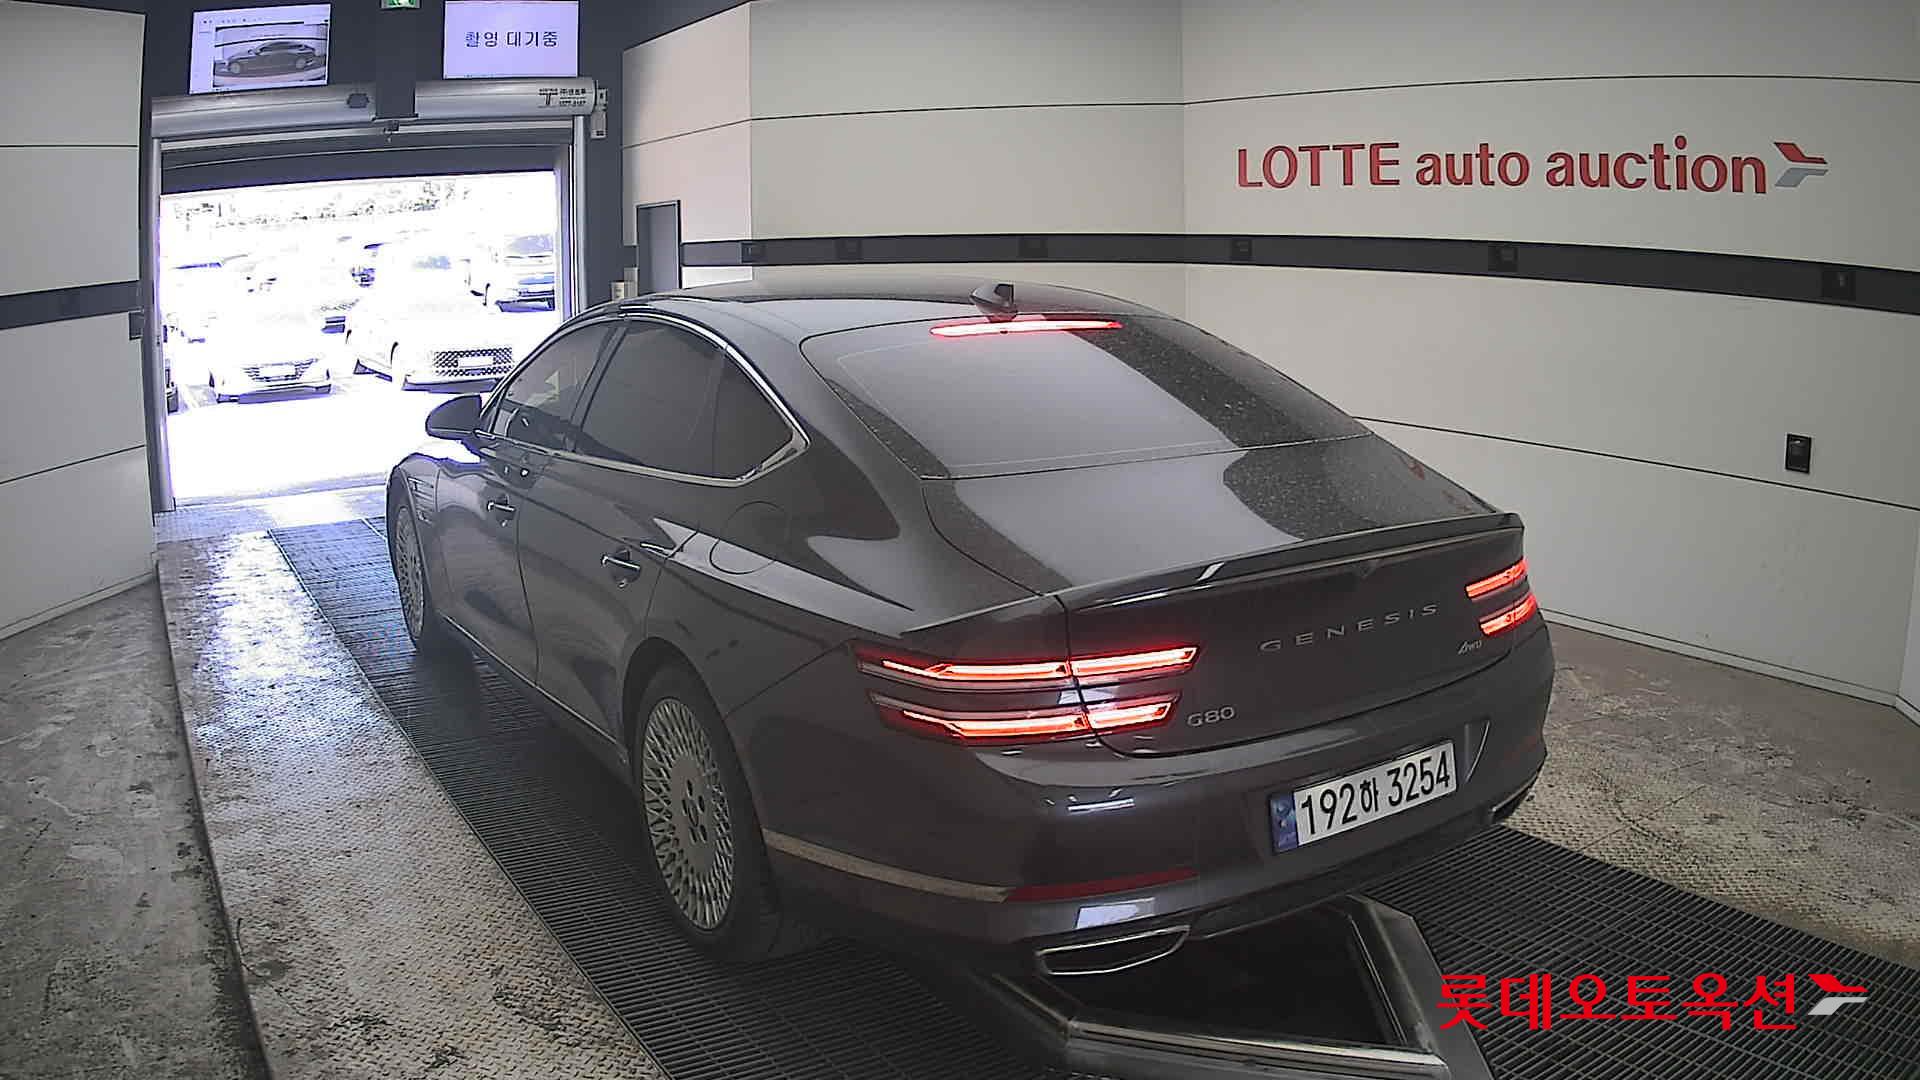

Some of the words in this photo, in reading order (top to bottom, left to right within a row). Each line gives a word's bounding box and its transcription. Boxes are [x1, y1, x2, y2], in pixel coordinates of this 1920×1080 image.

[506, 31, 558, 48] 대기중
[1238, 142, 1400, 189] LOTTE
[1415, 143, 1530, 187] auto
[1546, 135, 1767, 194] auction
[1259, 604, 1438, 652] GENESIS
[1187, 706, 1236, 727] G80
[1301, 781, 1379, 835] 192하
[1387, 751, 1451, 807] 3254
